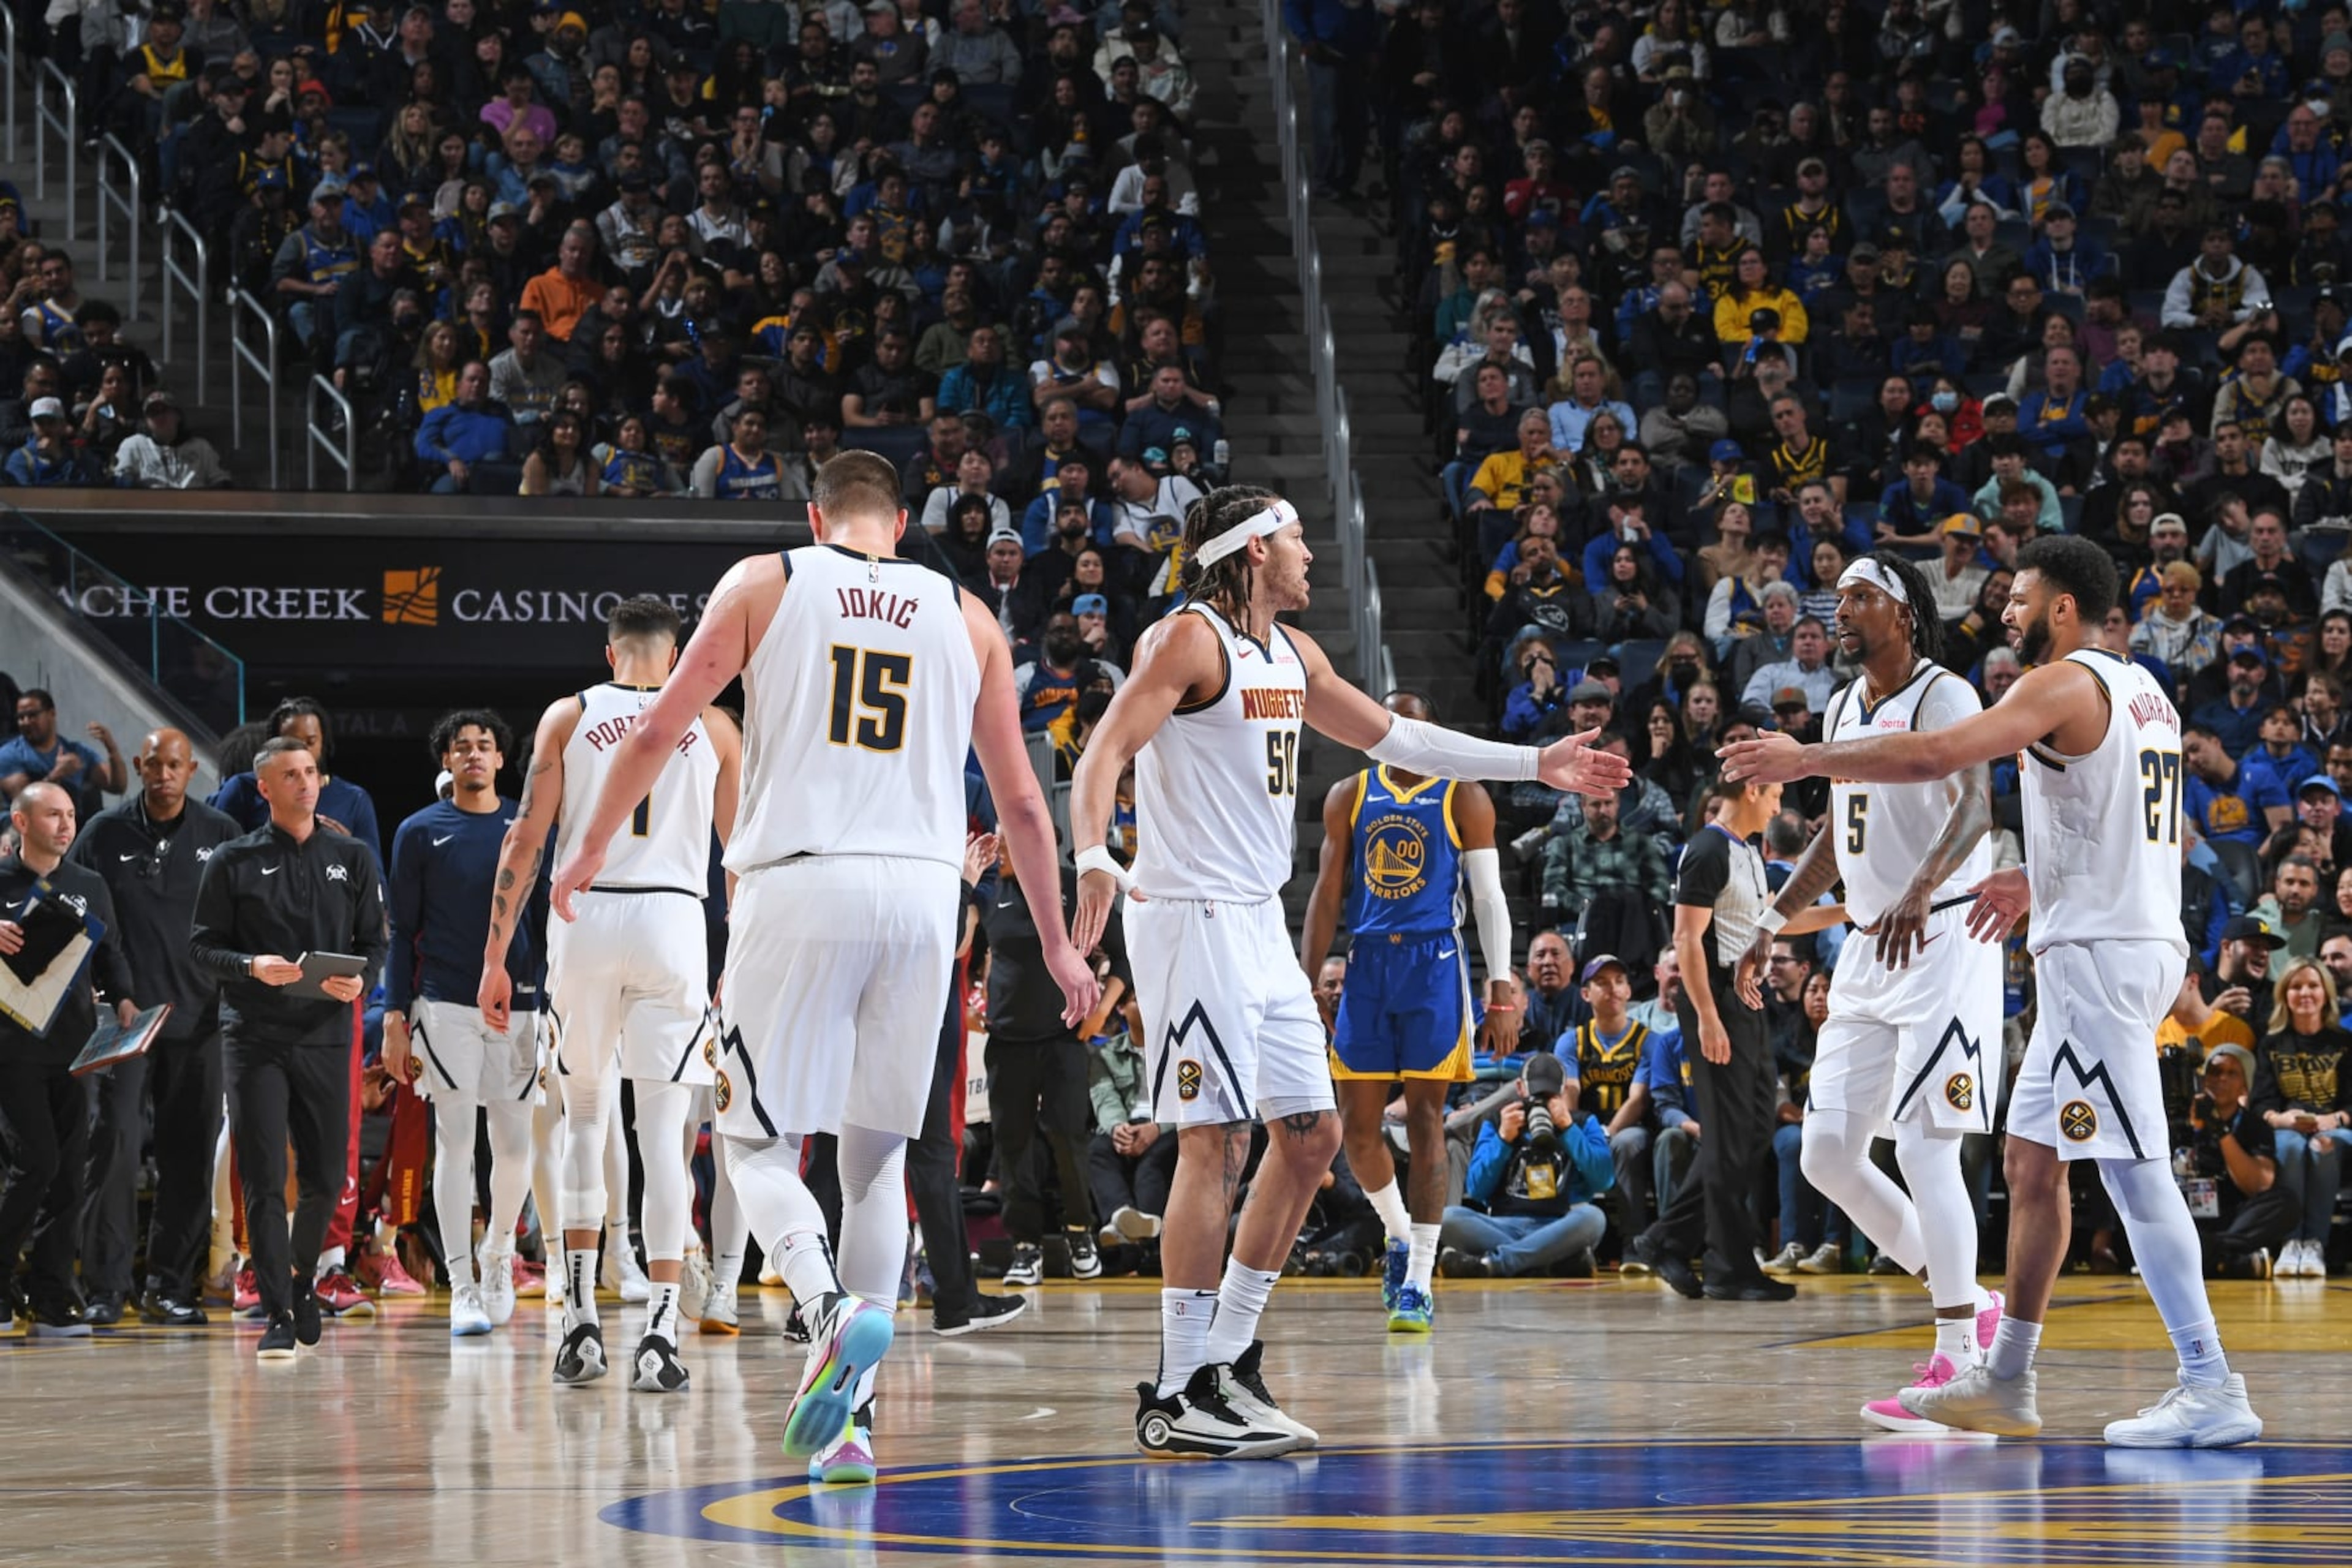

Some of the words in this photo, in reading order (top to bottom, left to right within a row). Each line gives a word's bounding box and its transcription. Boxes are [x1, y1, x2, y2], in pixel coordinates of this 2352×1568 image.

[204, 586, 371, 620] CREEK
[837, 587, 921, 630] JOKIĆ
[827, 642, 914, 753] 15
[1265, 729, 1297, 797] 50
[2139, 747, 2181, 846] 27
[1365, 813, 1403, 834] GOLDEN
[1405, 815, 1430, 839] STATE
[1847, 793, 1869, 856] 5
[1396, 840, 1419, 859] 00
[1363, 870, 1427, 900] WARRIORS
[1596, 1085, 1623, 1109] 11
